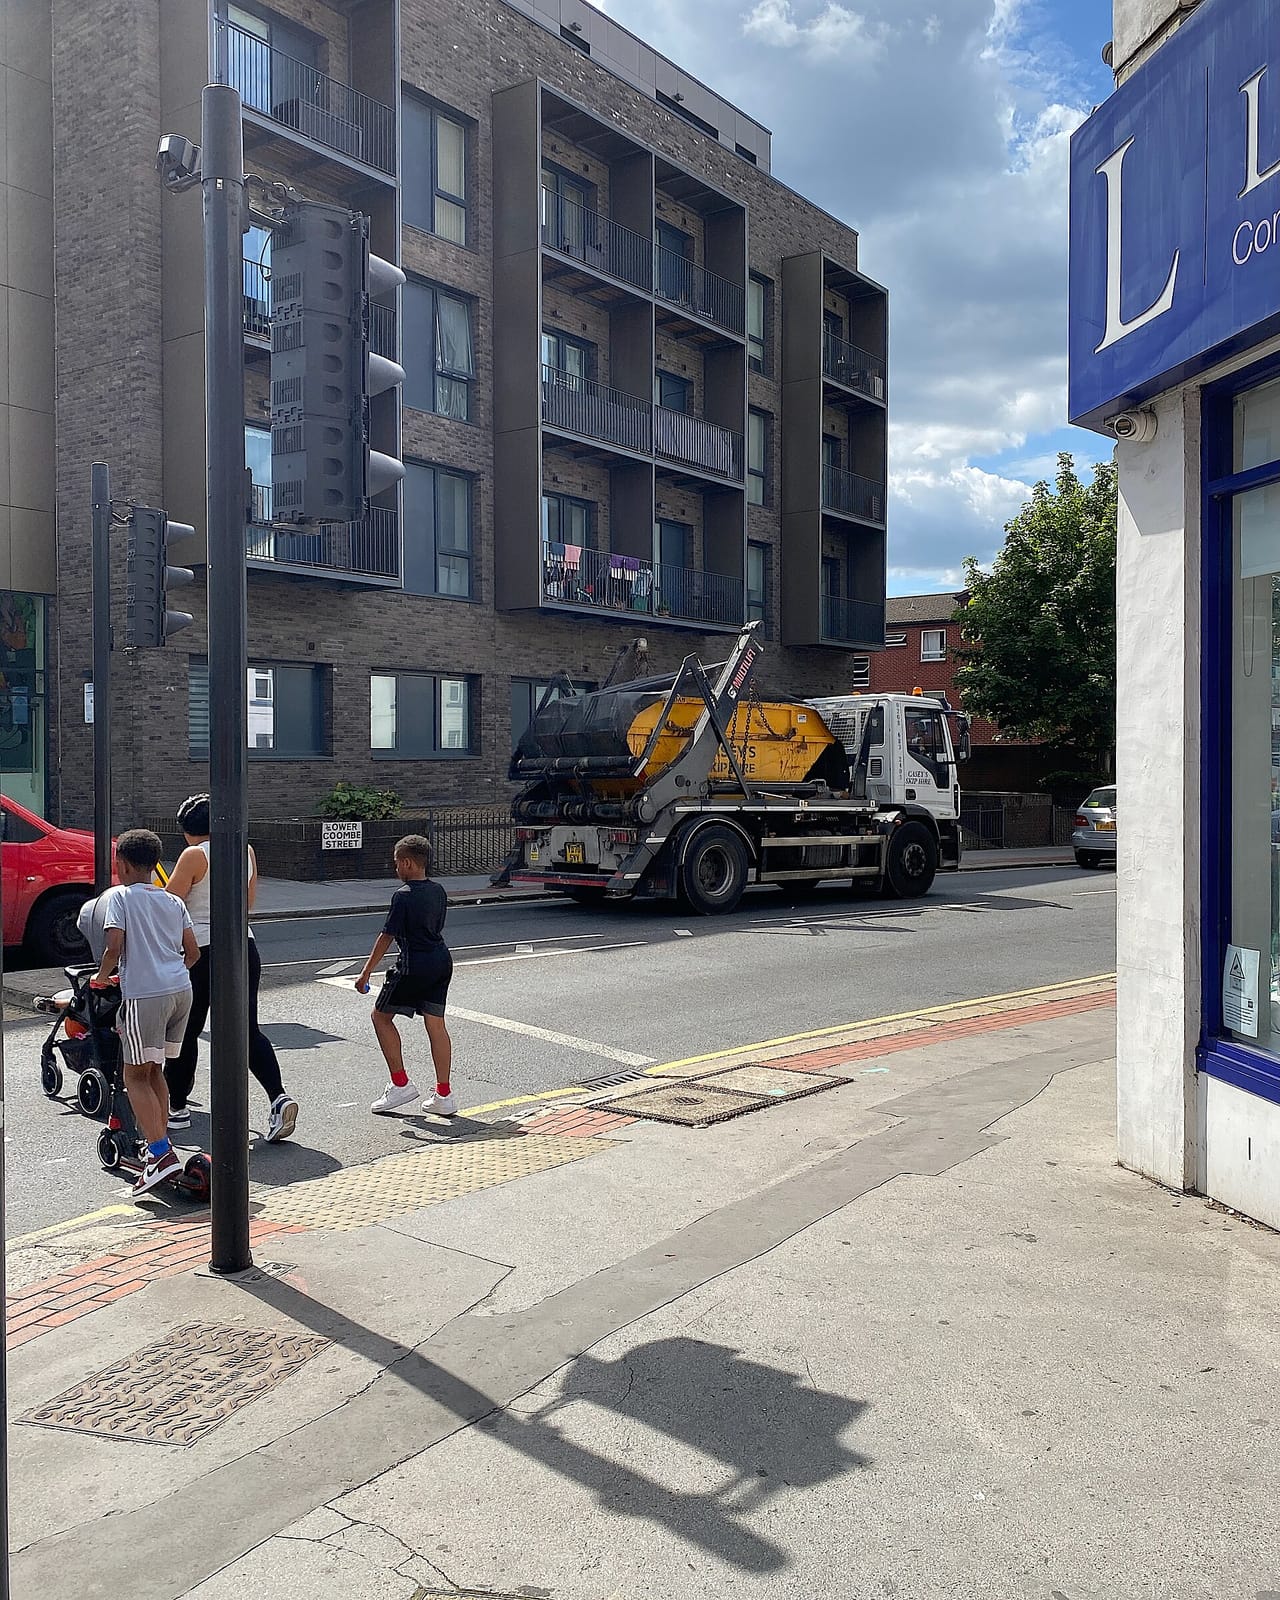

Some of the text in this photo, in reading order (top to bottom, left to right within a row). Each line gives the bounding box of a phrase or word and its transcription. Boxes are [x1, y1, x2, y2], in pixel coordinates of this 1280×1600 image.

[1094, 135, 1180, 354] L
[325, 823, 358, 831] LOWER
[323, 831, 361, 840] COOMBE
[325, 840, 359, 848] STREET
